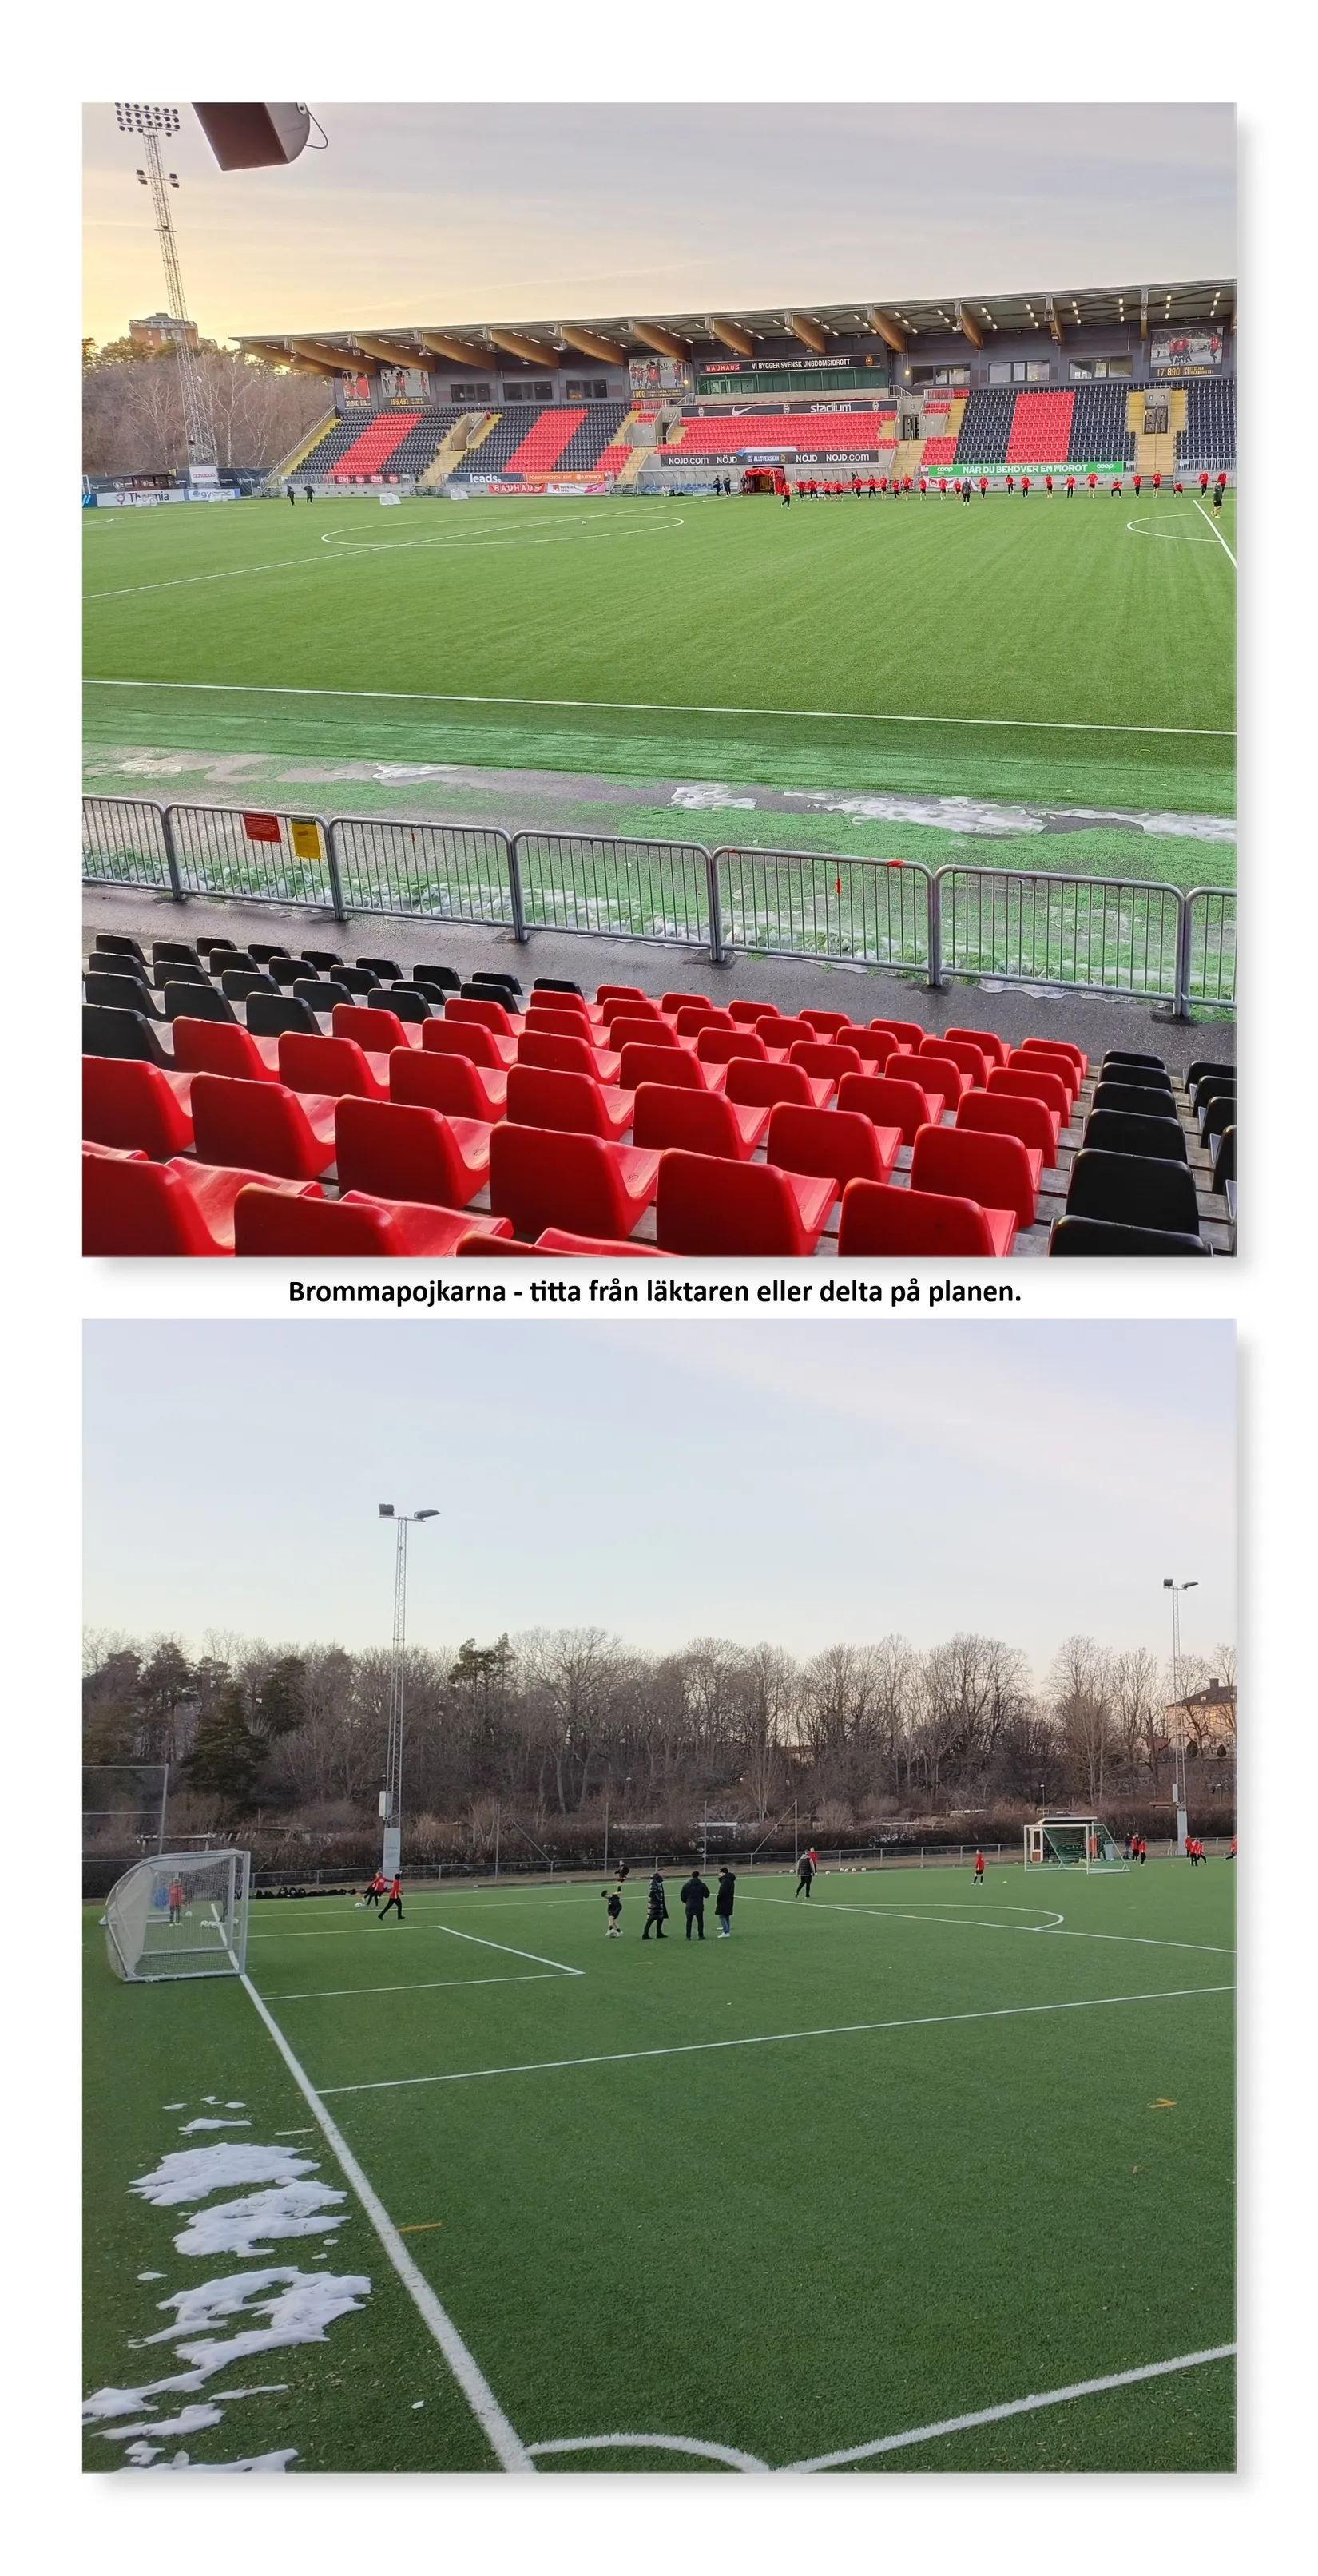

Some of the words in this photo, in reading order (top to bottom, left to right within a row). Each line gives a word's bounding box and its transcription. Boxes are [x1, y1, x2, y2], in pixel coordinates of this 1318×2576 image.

[706, 363, 740, 372] BAUHAUS
[803, 359, 851, 367] UNGDOMSIDROTT
[810, 402, 852, 413] stadium
[717, 454, 738, 464] NÖJD
[796, 453, 818, 462] NÖJD
[963, 465, 982, 474] NÄR
[996, 464, 1039, 474] BEHÖVER
[1040, 464, 1053, 473] EN
[1054, 464, 1089, 473] MOROT
[494, 483, 540, 493] BAUHAUS
